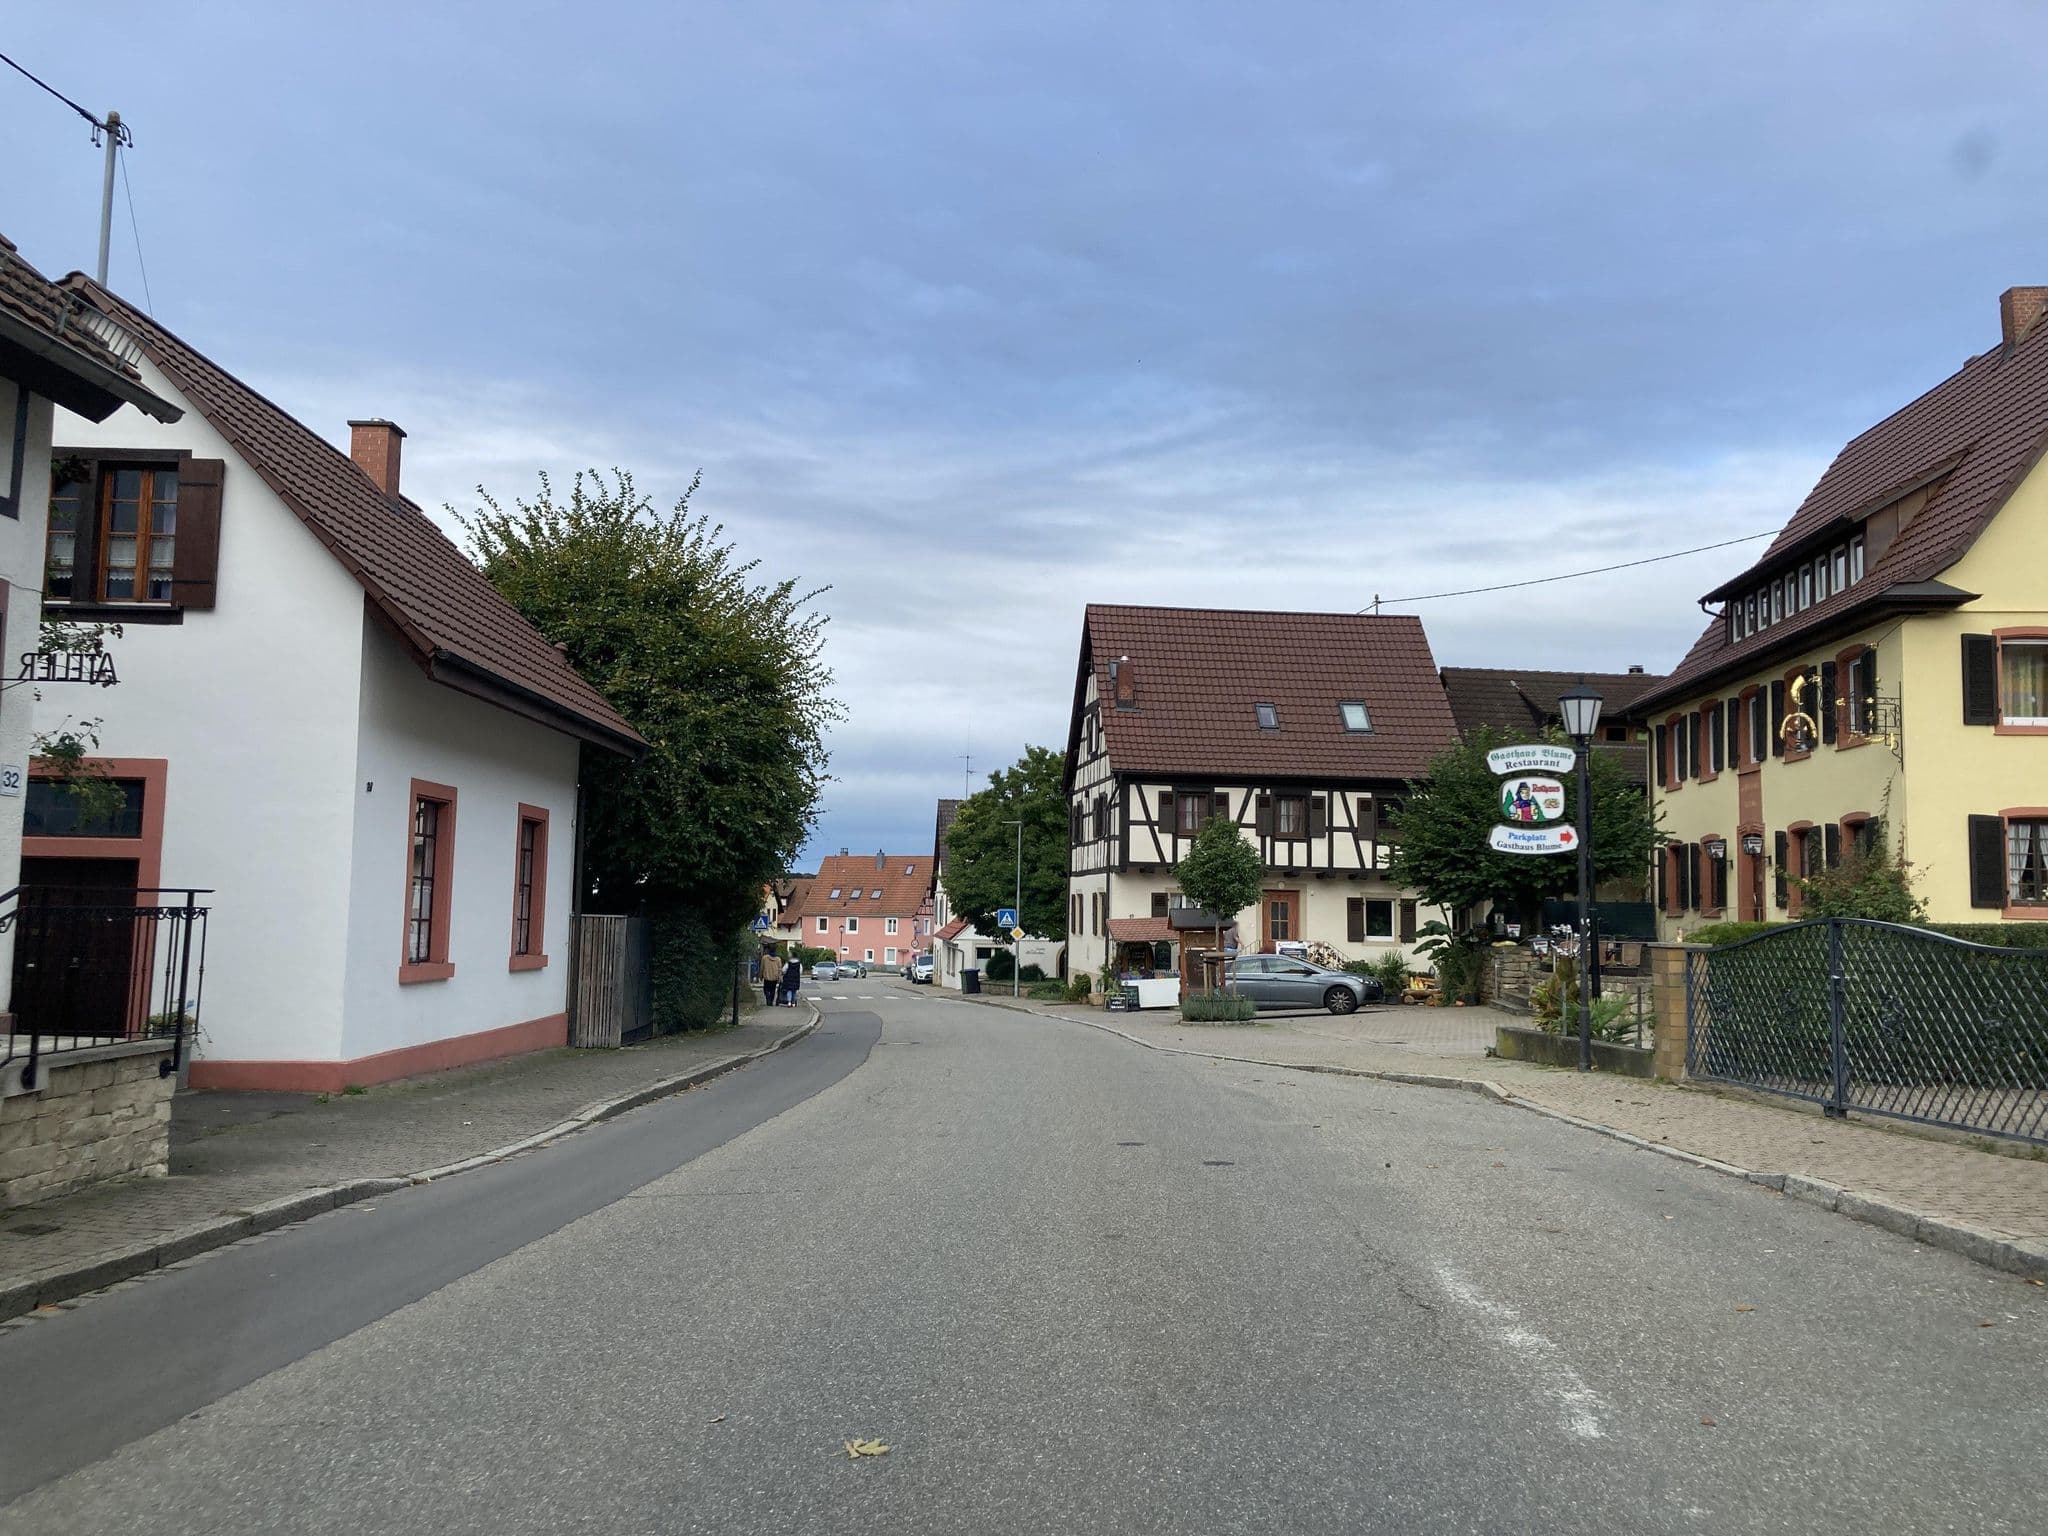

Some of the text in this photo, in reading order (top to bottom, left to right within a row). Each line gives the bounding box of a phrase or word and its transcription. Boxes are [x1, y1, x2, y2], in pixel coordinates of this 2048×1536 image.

[1490, 748, 1572, 761] Gasthaus Blume
[1505, 759, 1560, 769] Restaurant
[3, 771, 20, 789] 32
[1508, 832, 1546, 842] Parkplatz
[1496, 840, 1534, 851] Gasthaus
